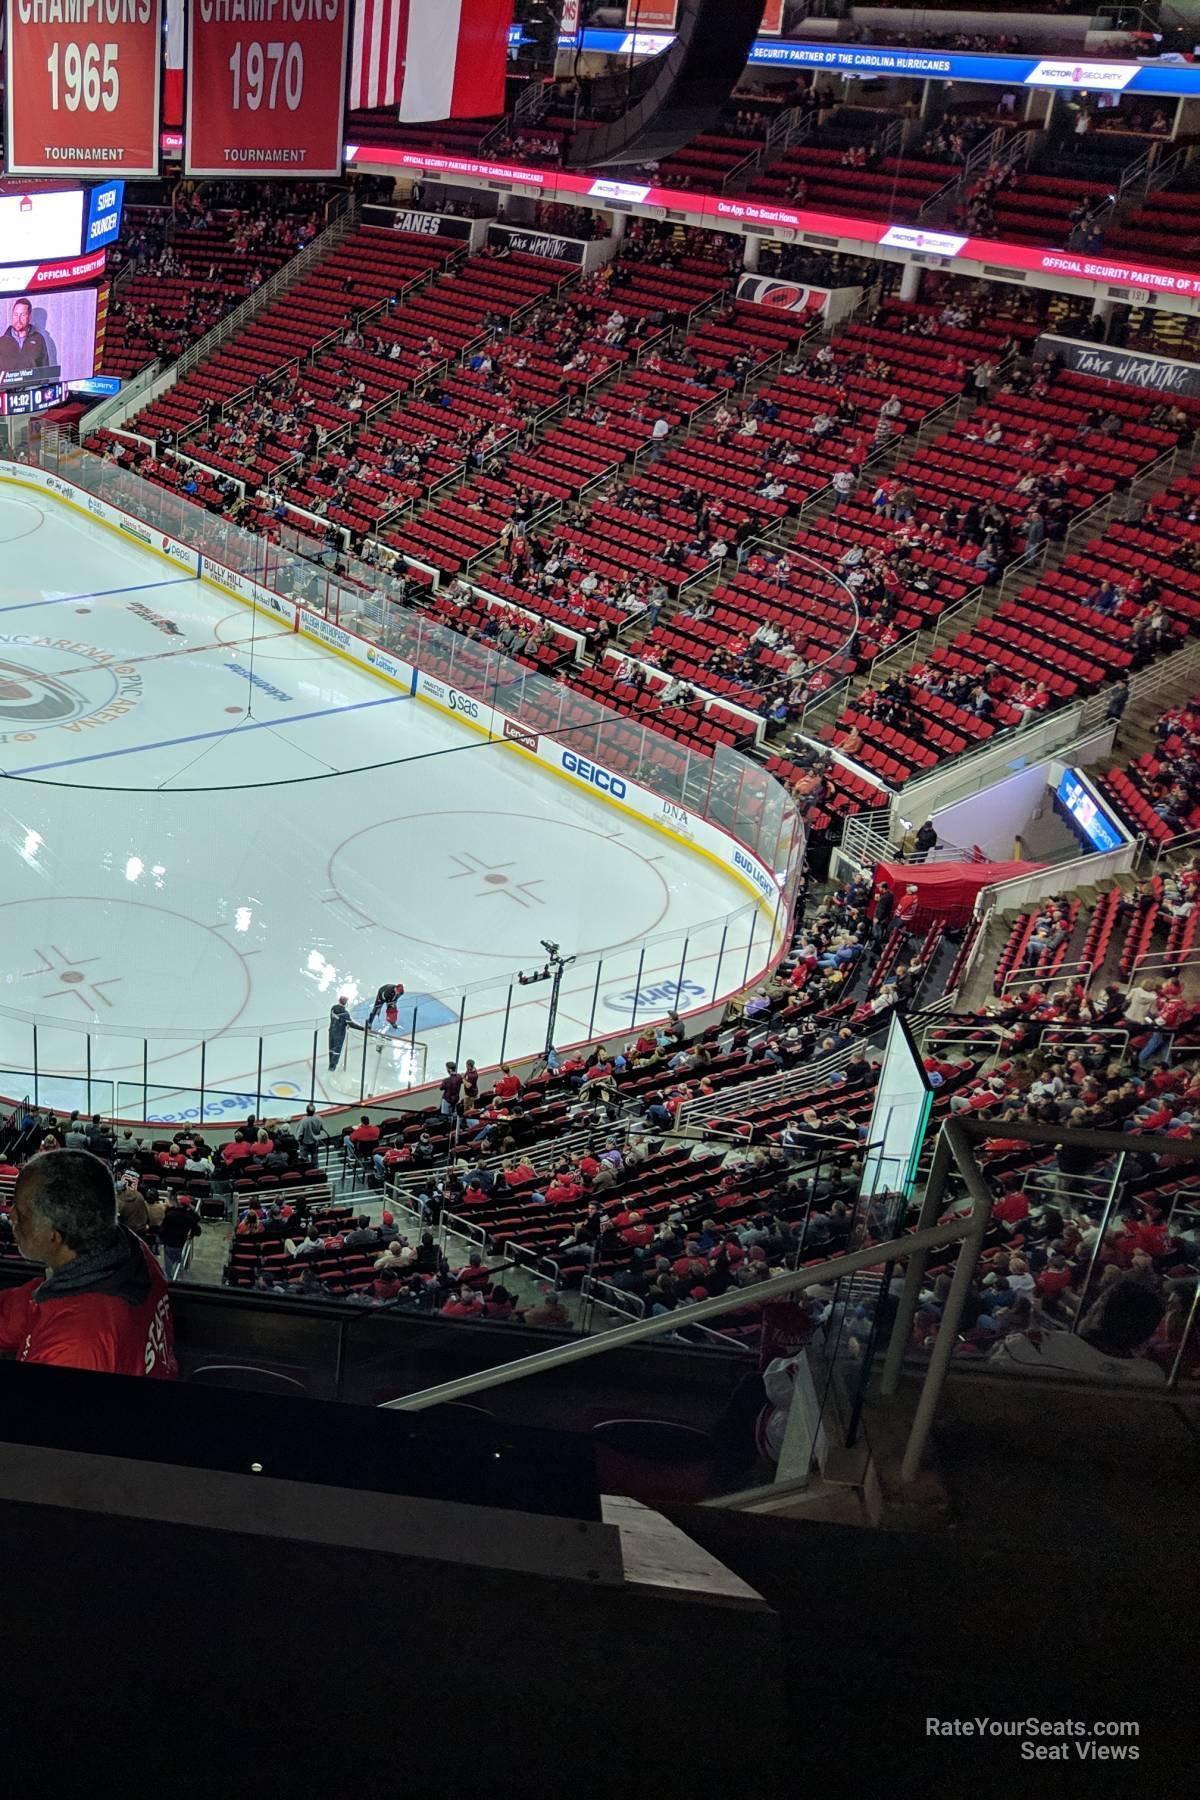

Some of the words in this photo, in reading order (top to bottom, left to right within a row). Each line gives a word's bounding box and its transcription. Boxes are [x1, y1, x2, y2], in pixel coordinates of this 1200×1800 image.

[18, 0, 150, 24] CHAMPIONS
[200, 0, 338, 23] CHAMPIONS
[754, 48, 789, 59] SECURITY
[790, 51, 824, 62] PARTNER
[826, 53, 836, 62] OF
[838, 54, 853, 64] THE
[855, 55, 895, 67] CAROLINA
[896, 58, 950, 71] HURRICANES
[48, 42, 120, 112] 1965
[229, 41, 304, 110] 1970
[1041, 69, 1072, 78] VECTOR
[1082, 71, 1122, 80] SECURITY
[44, 147, 125, 162] TOURNAMENT
[223, 148, 306, 162] TOURNAMENT
[403, 155, 425, 165] OFFICIAL
[425, 157, 448, 168] SECURITY
[97, 188, 116, 212] SIREN
[393, 213, 441, 235] CANES
[718, 202, 731, 213] One
[731, 205, 745, 216] App.
[746, 207, 758, 218] One
[759, 209, 778, 221] Smart
[778, 211, 799, 224] Home.
[91, 215, 117, 238] SOUNDER
[37, 268, 70, 281] OFFICIAL
[72, 262, 97, 276] SECURITY
[1042, 257, 1082, 272] OFFICIAL
[1084, 264, 1130, 279] SECURITY
[1130, 271, 1175, 287] PARTNER
[1176, 279, 1191, 289] OF
[9, 394, 29, 407] 14:02
[35, 390, 42, 403] 0
[171, 544, 190, 562] pepsi
[203, 558, 226, 577] BULLY
[227, 571, 243, 588] HILL
[301, 611, 320, 629] RALEIGH
[320, 620, 351, 647] ORTHOPAEDIC
[32, 636, 116, 663] ARENA
[375, 658, 398, 677] Lottery
[120, 673, 143, 698] PNC
[224, 663, 294, 702] ticketmaster
[60, 697, 138, 733] ARENA
[505, 724, 537, 749] Lenovo
[562, 751, 627, 799] GEICO
[663, 801, 688, 824] DNA
[734, 851, 753, 874] BUD
[752, 868, 774, 897] LIGHT
[625, 980, 705, 1006] Spirit
[145, 1294, 170, 1374] STAFF
